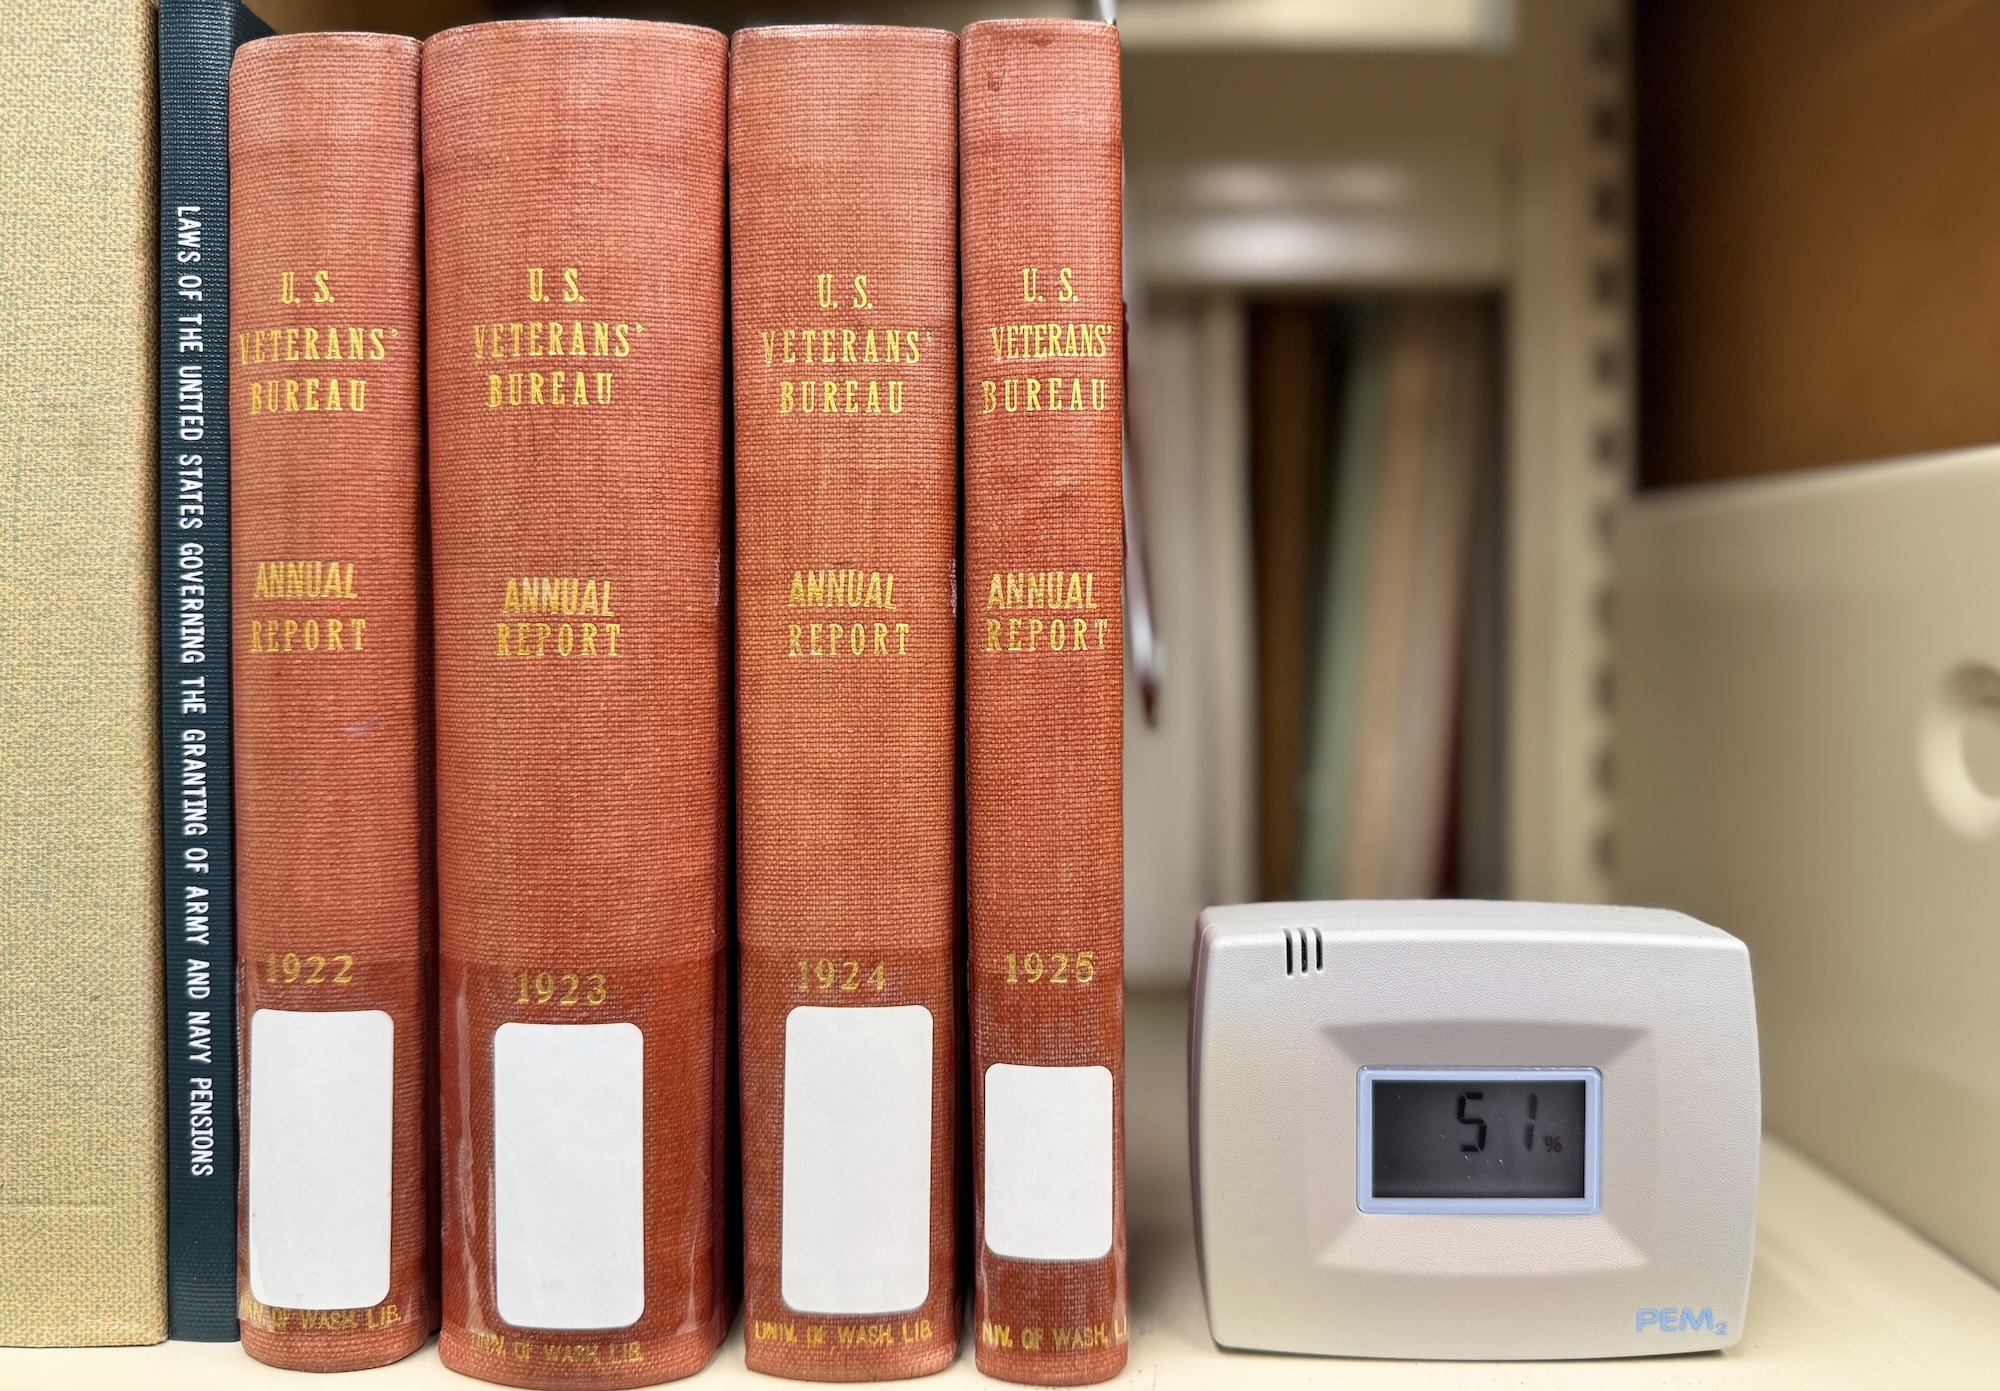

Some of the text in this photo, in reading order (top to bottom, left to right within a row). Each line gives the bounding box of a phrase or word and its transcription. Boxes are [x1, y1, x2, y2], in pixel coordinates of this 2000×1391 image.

[282, 270, 336, 304] U. S.
[528, 268, 586, 303] U. S.
[817, 274, 873, 309] U. S.
[1022, 268, 1079, 303] U. S.
[239, 326, 400, 366] VETERANS'
[473, 322, 645, 359] VETERANS'
[990, 323, 1112, 361] VETERANS'
[249, 379, 368, 415] BUREAU
[488, 372, 614, 407] BUREAU
[779, 380, 905, 414] BUREAU
[982, 378, 1108, 413] BUREAU
[254, 560, 358, 600] ANNUAL
[503, 577, 614, 617] ANNUAL
[788, 569, 897, 610] ANNUAL
[987, 571, 1098, 610] ANNUAL
[250, 618, 367, 652] REPORT
[497, 623, 621, 656] REPORT
[788, 622, 910, 656] REPORT
[987, 618, 1109, 652] REPORT
[176, 205, 214, 1176] LAWS OF THE UNITED STATES GOVERNING THE GRANTING OF ARMY AND NAVY PENSIONS
[264, 952, 355, 985] 1922
[797, 959, 887, 991] 1924
[1005, 951, 1095, 984] 1925
[514, 972, 608, 1006] 1923
[1114, 1315, 1129, 1341] LI
